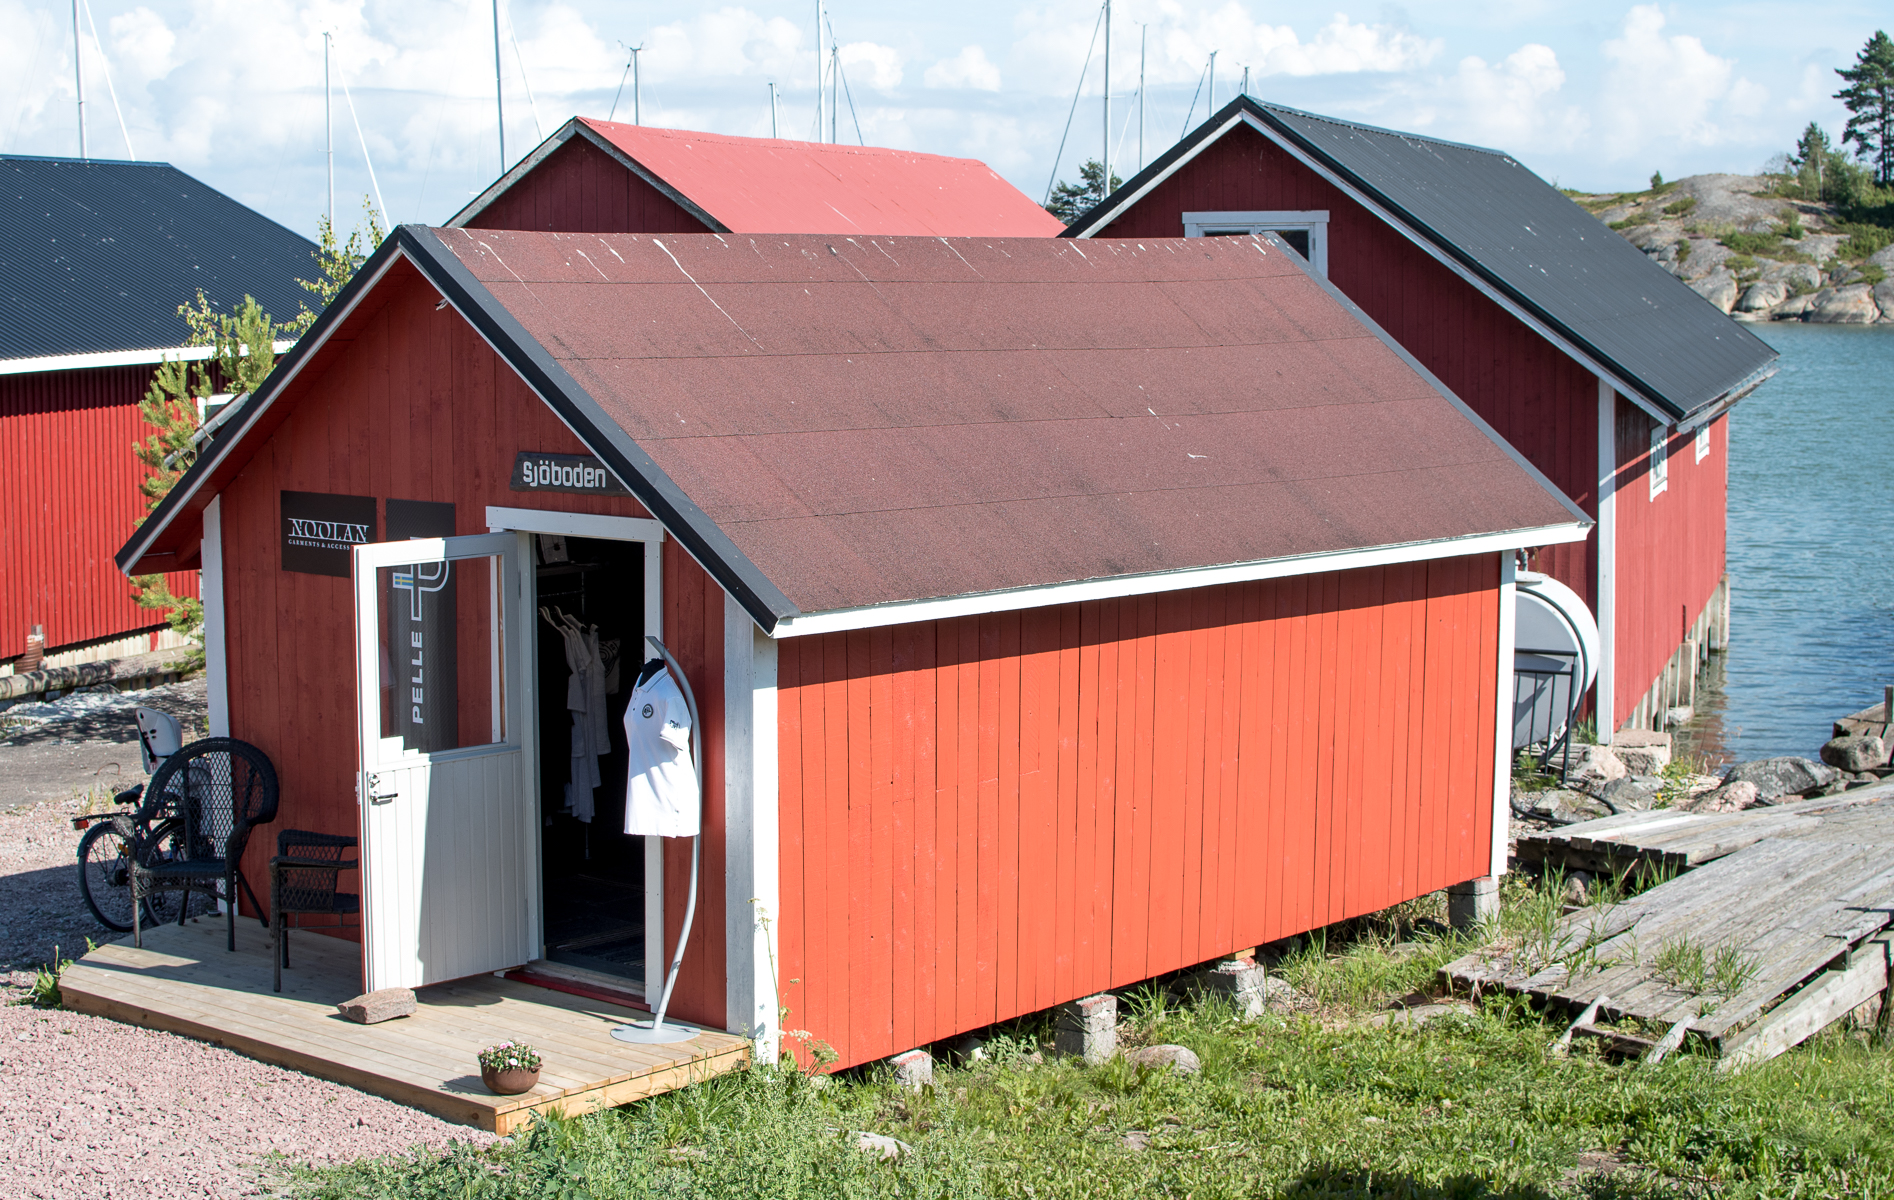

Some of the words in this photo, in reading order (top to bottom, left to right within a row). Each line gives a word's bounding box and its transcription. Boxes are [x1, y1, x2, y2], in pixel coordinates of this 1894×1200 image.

[288, 518, 369, 543] NOOLAN
[288, 539, 320, 548] GARMENTS
[327, 543, 350, 551] ACCESS
[411, 631, 424, 724] PELLE
